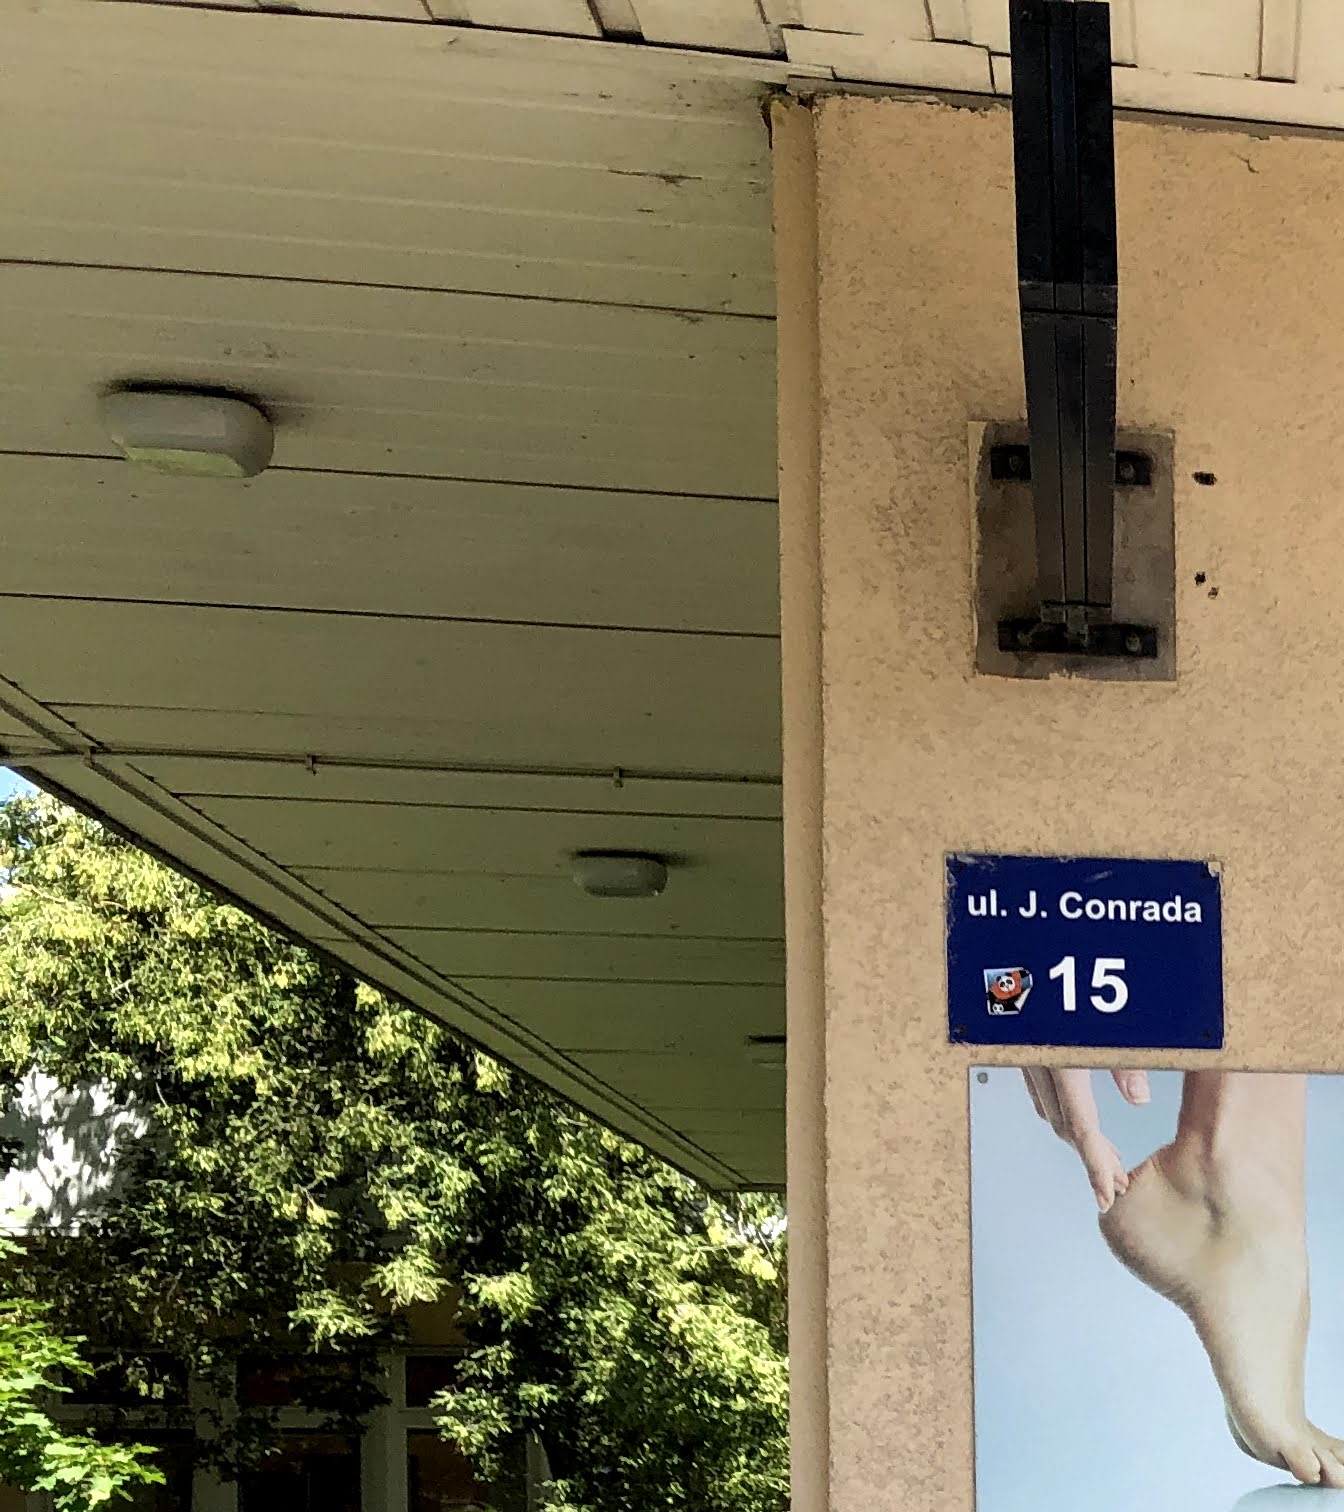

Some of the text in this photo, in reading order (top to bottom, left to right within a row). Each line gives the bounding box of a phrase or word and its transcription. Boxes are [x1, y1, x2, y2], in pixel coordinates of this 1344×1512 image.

[968, 889, 1202, 923] ul. J. Conrada
[1049, 956, 1129, 1013] 15
